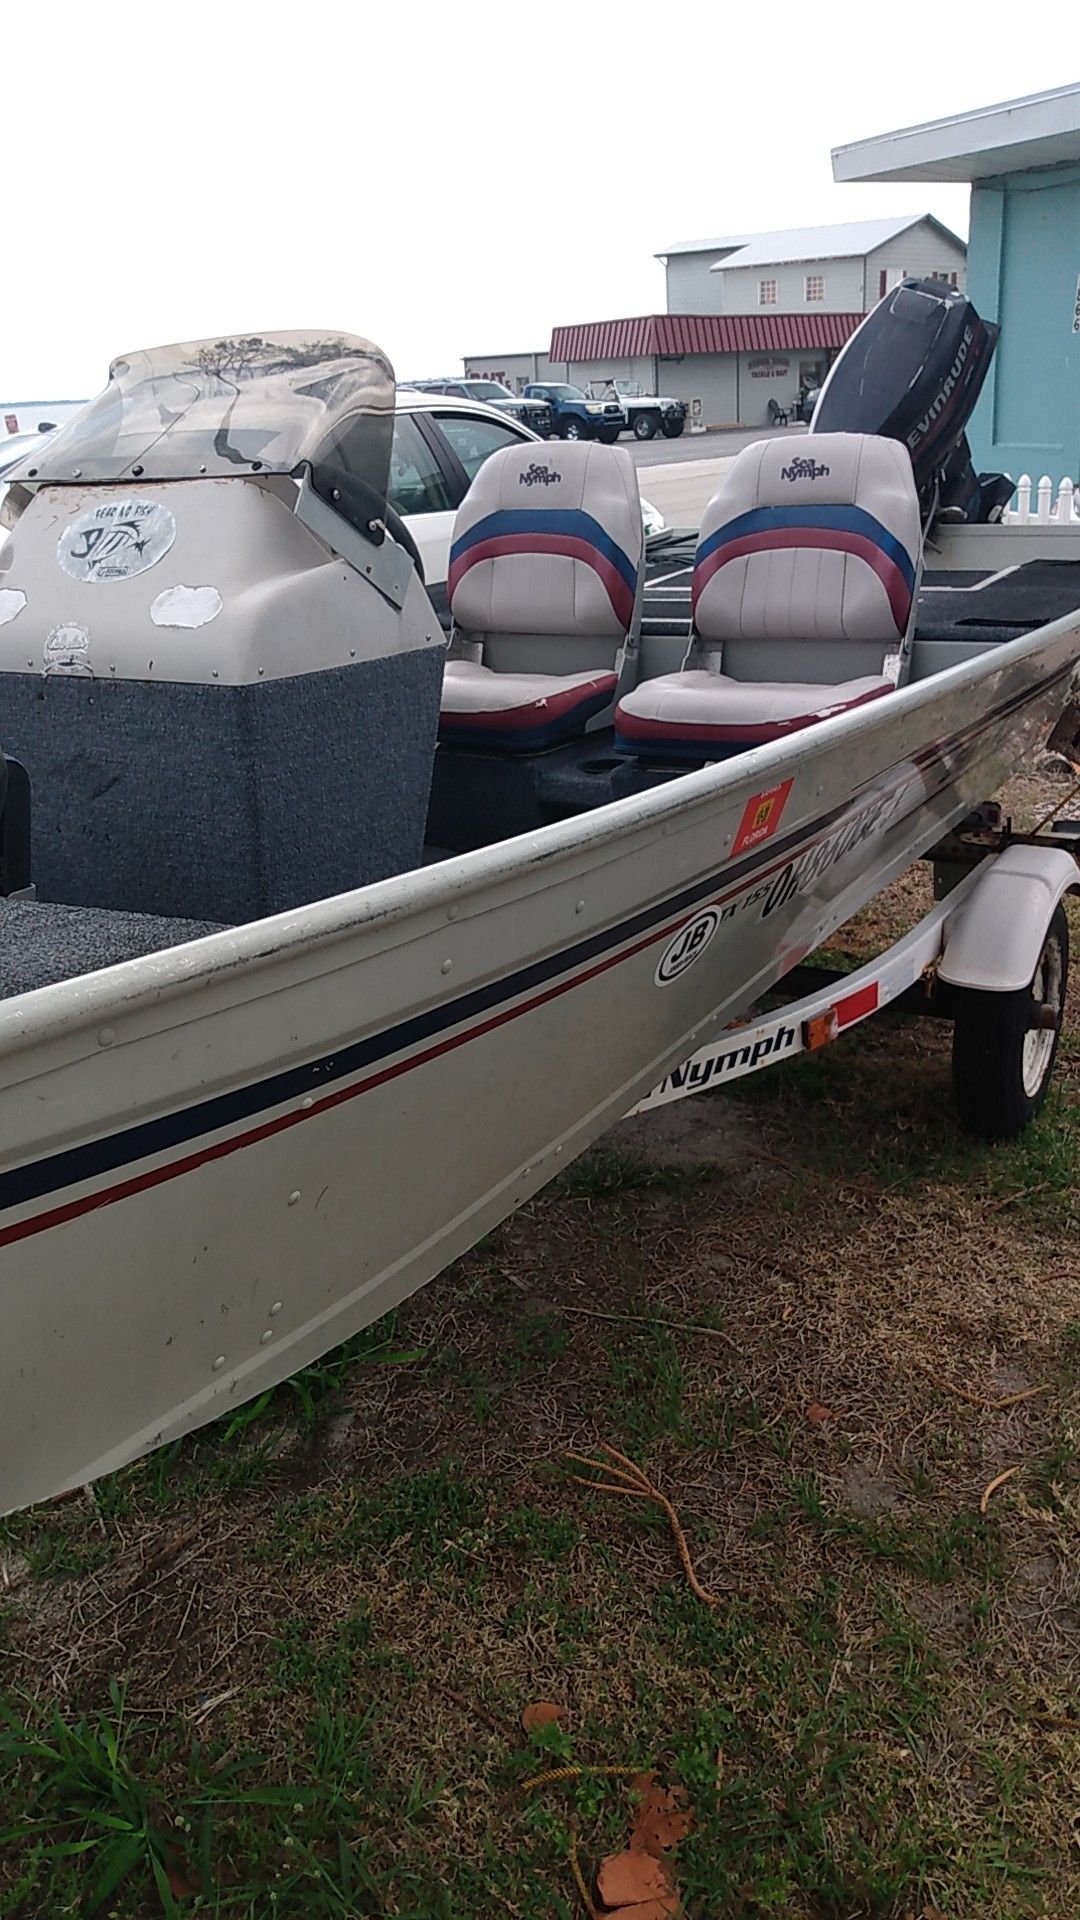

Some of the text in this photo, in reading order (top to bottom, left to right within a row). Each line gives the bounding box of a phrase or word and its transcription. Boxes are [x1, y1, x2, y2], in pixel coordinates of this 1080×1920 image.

[906, 325, 973, 448] EVINRUDE
[528, 463, 548, 474] Sea
[791, 457, 815, 468] Sea
[519, 471, 561, 486] Nymph
[781, 465, 829, 482] Nymph
[670, 919, 710, 964] JB
[660, 1026, 794, 1091] Nymph
